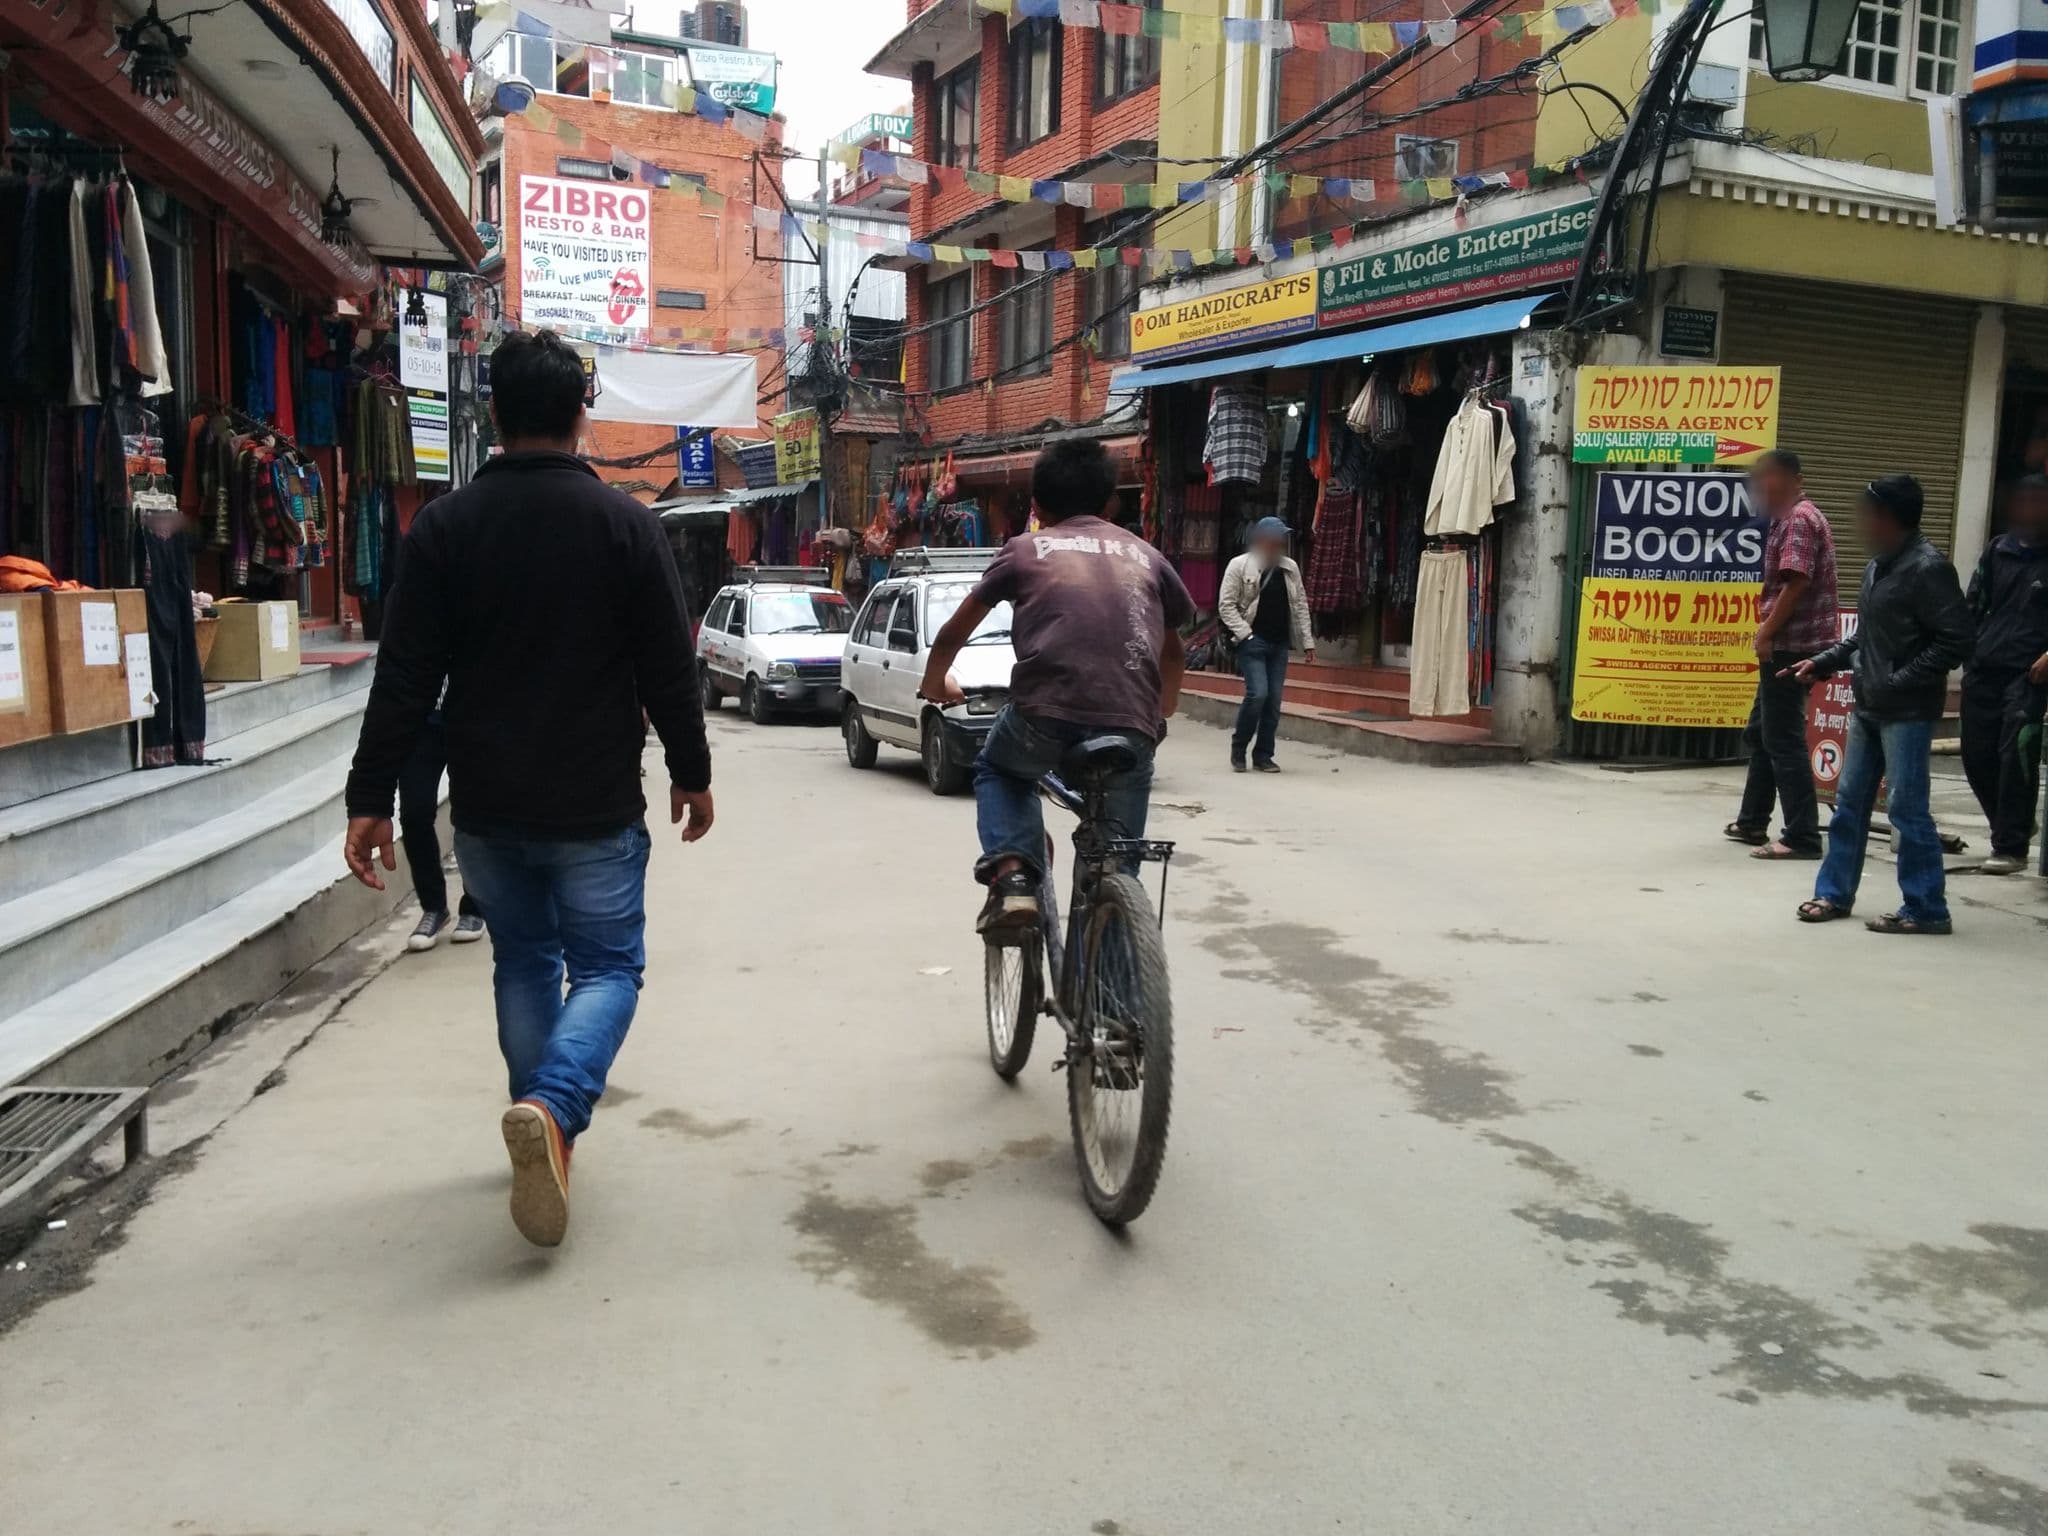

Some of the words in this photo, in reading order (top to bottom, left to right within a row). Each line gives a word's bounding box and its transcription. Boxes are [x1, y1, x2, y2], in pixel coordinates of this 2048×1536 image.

[873, 115, 910, 135] HOLY
[524, 182, 646, 223] ZIBRO
[524, 214, 584, 233] RESTO
[592, 222, 603, 236] &
[610, 224, 646, 241] BAR
[523, 239, 549, 255] HAVE
[551, 243, 570, 259] YOU
[573, 245, 608, 263] VISITED
[610, 249, 623, 263] US
[625, 251, 647, 263] YET?
[1340, 261, 1366, 287] Fil
[1371, 258, 1387, 279] &
[1393, 244, 1450, 275] Mode
[1457, 207, 1599, 259] Enterprises
[524, 267, 556, 283] WiFi
[559, 274, 581, 286] LIVE
[583, 269, 614, 282] MUSIC
[1405, 290, 1437, 304] Exporter
[1500, 270, 1526, 286] Cotton
[1529, 268, 1539, 279] all
[1540, 264, 1564, 277] kinds
[1565, 261, 1576, 271] of
[523, 289, 573, 301] BREAKFAST
[580, 292, 609, 303] LUNCH
[615, 295, 647, 306] DINNER
[1146, 311, 1172, 330] OM
[1177, 276, 1311, 323] HANDICRAFTS
[534, 307, 573, 319] REASONABLY
[574, 309, 596, 323] PRICED
[1178, 324, 1215, 340] Wholesaler
[1215, 323, 1221, 331] &
[1222, 315, 1253, 331] Exporter
[1589, 376, 1680, 409] סוויסה
[1683, 376, 1773, 409] סוכנות
[1588, 415, 1669, 430] SWISSA
[1677, 416, 1769, 431] AGENCY
[1679, 432, 1717, 448] TICKET
[1717, 443, 1741, 451] Floor
[1606, 448, 1682, 463] AVAILABLE
[1612, 479, 1758, 518] VISION
[1603, 525, 1762, 564] BOOKS
[1632, 568, 1662, 581] RARE
[1665, 569, 1687, 582] AND
[1689, 570, 1710, 582] OUT
[1713, 570, 1728, 583] OF
[1730, 570, 1762, 583] PRINT
[1593, 589, 1681, 622] סוויסה
[1588, 626, 1617, 643] SWISSA
[1618, 627, 1650, 645] RAFTING
[1660, 630, 1698, 646] TREKKING
[1700, 632, 1741, 648] EXPEDITION
[1630, 648, 1656, 657] Serving
[1606, 660, 1641, 669] SWISSA
[1642, 661, 1679, 671] AGENCY
[1681, 663, 1691, 671] IN
[1693, 663, 1717, 672] FIRST
[1719, 664, 1747, 672] FLOOR
[1825, 683, 1833, 701] 2
[1833, 684, 1856, 708] Nigh
[1579, 710, 1597, 719] All
[1602, 711, 1642, 722] Kinds
[1648, 713, 1660, 723] of
[1665, 714, 1712, 725] Permit
[1715, 716, 1726, 725] &
[1814, 707, 1827, 732] Dep.
[1828, 713, 1845, 735] every
